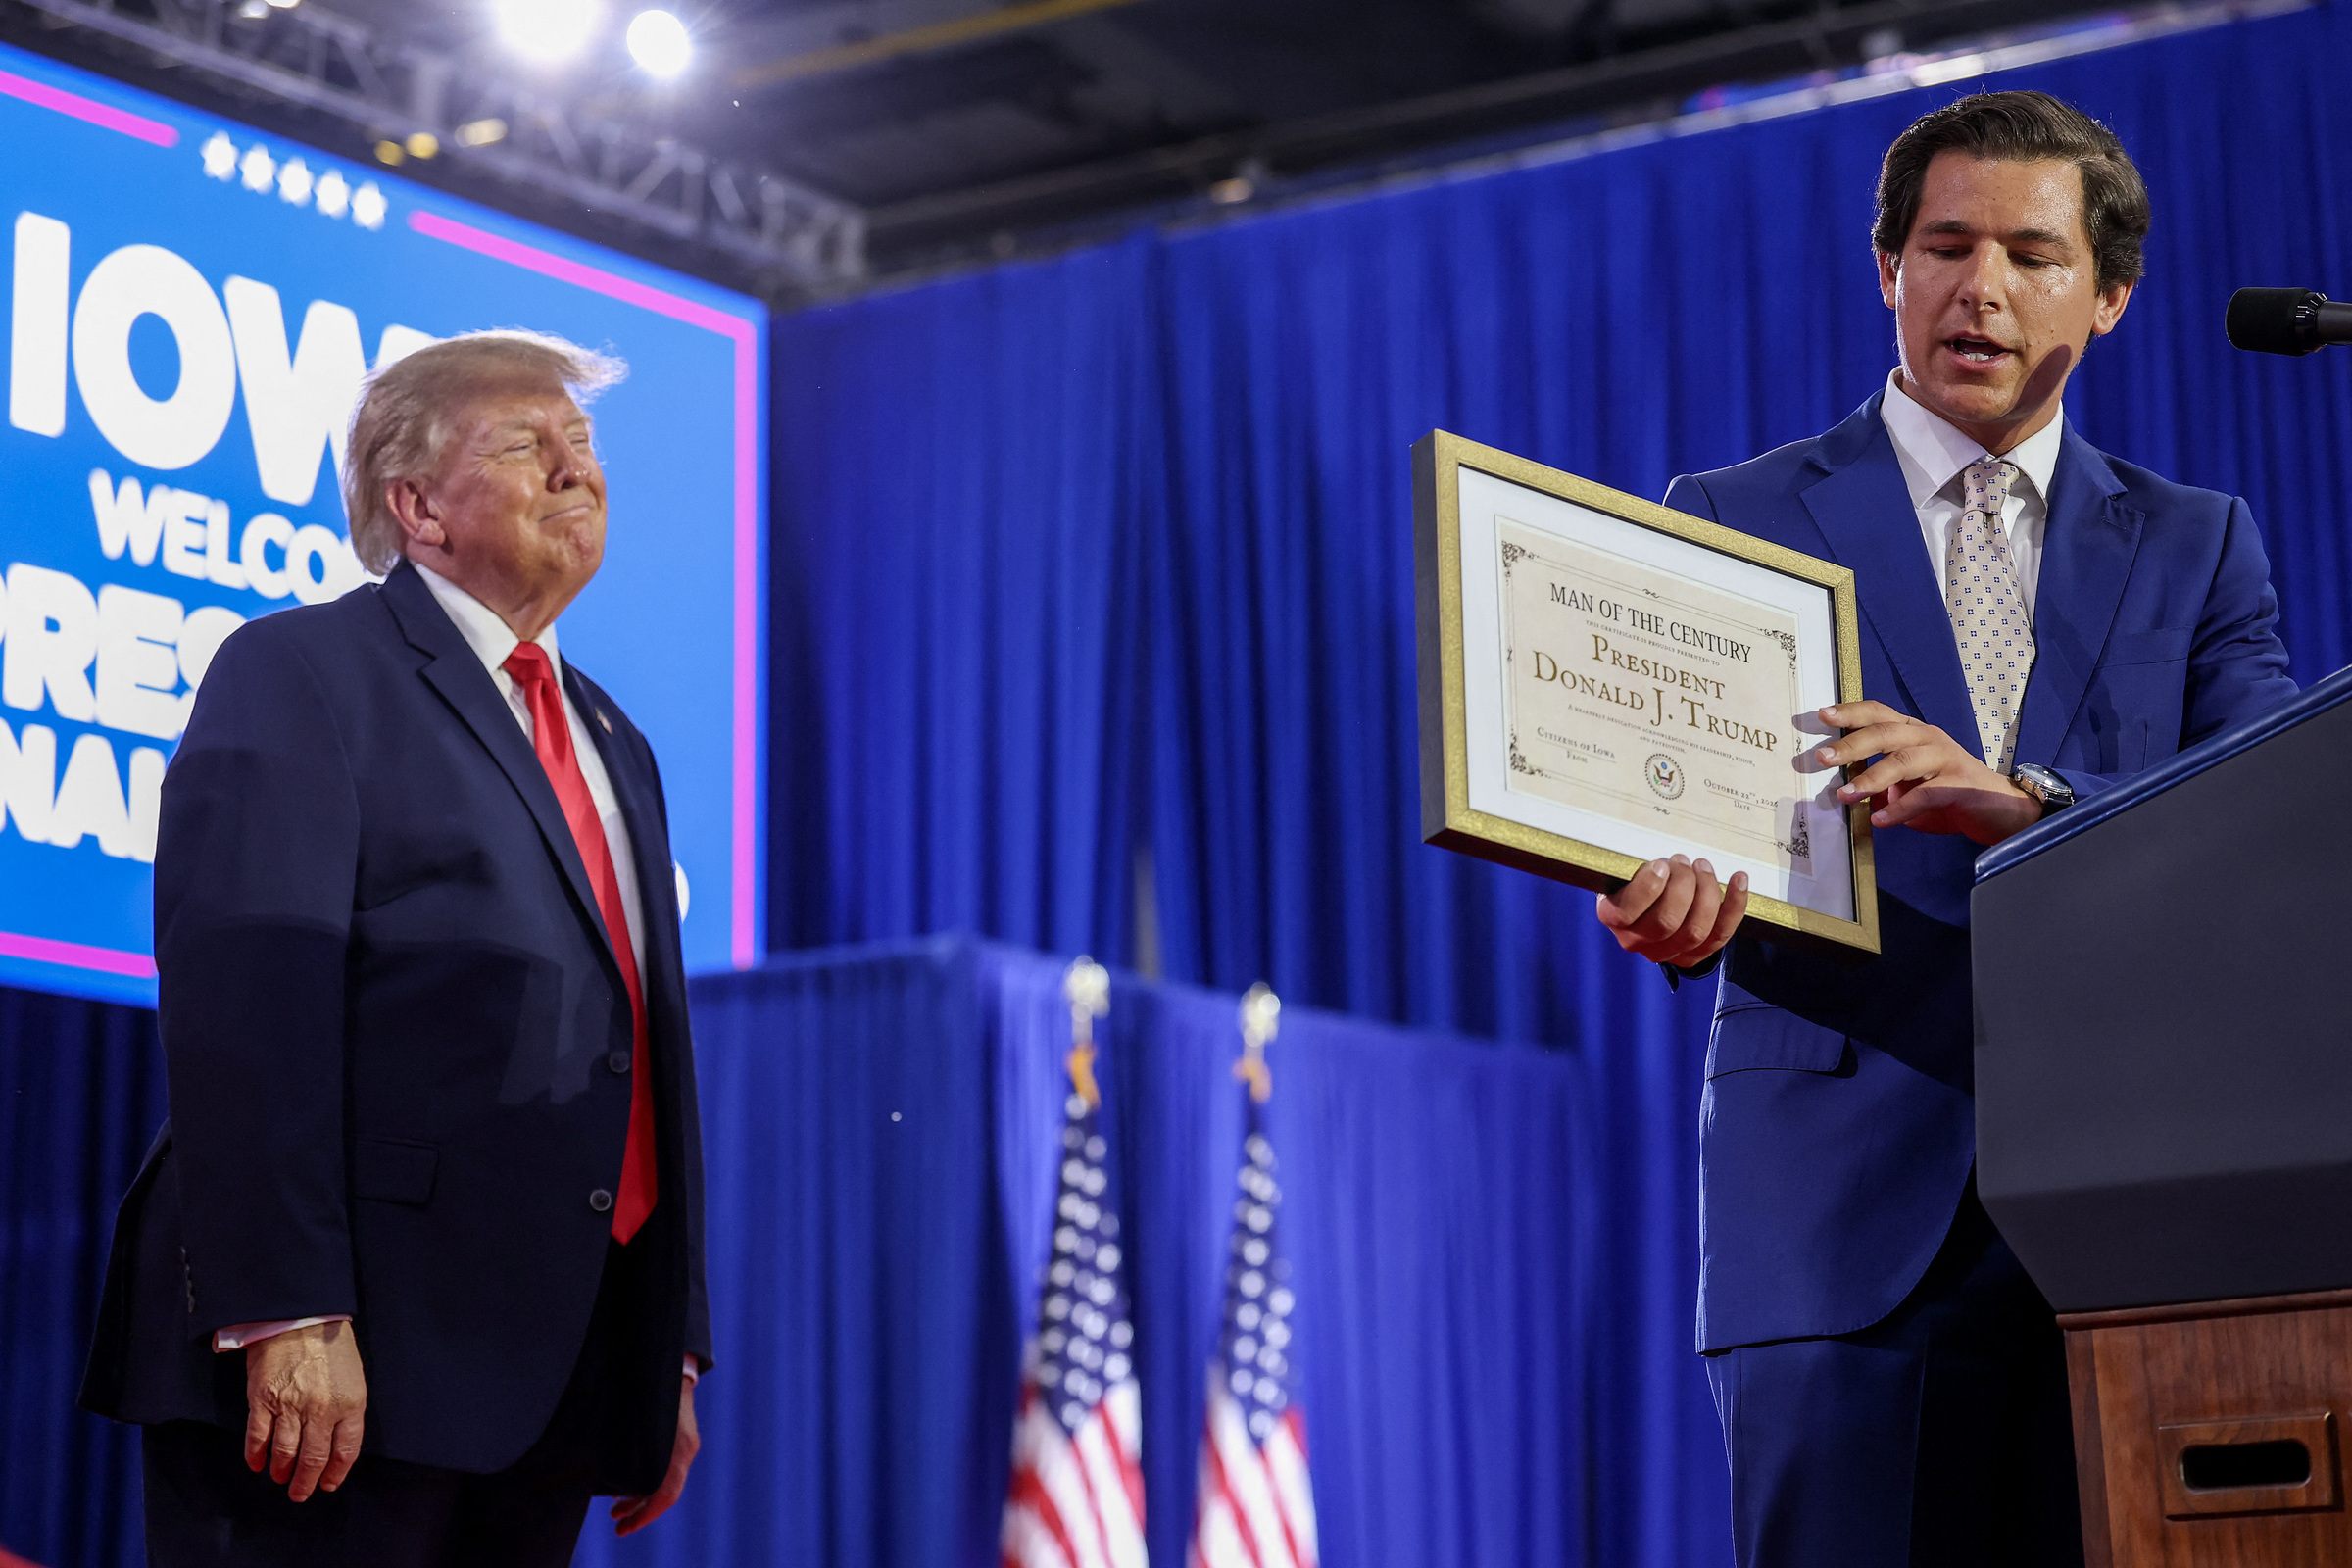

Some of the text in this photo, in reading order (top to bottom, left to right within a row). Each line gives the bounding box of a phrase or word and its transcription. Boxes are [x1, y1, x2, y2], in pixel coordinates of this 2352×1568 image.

[88, 467, 387, 606] WELCO
[1549, 582, 1751, 663] MAN OF THE CENTURY
[1600, 625, 1640, 642] CERTIFICATE
[1648, 639, 1676, 653] PROUDLY
[1677, 649, 1710, 663] PRESENTED
[1532, 650, 1778, 752] DONALD J. TRUMP
[1591, 633, 1726, 700] PRESIDENT
